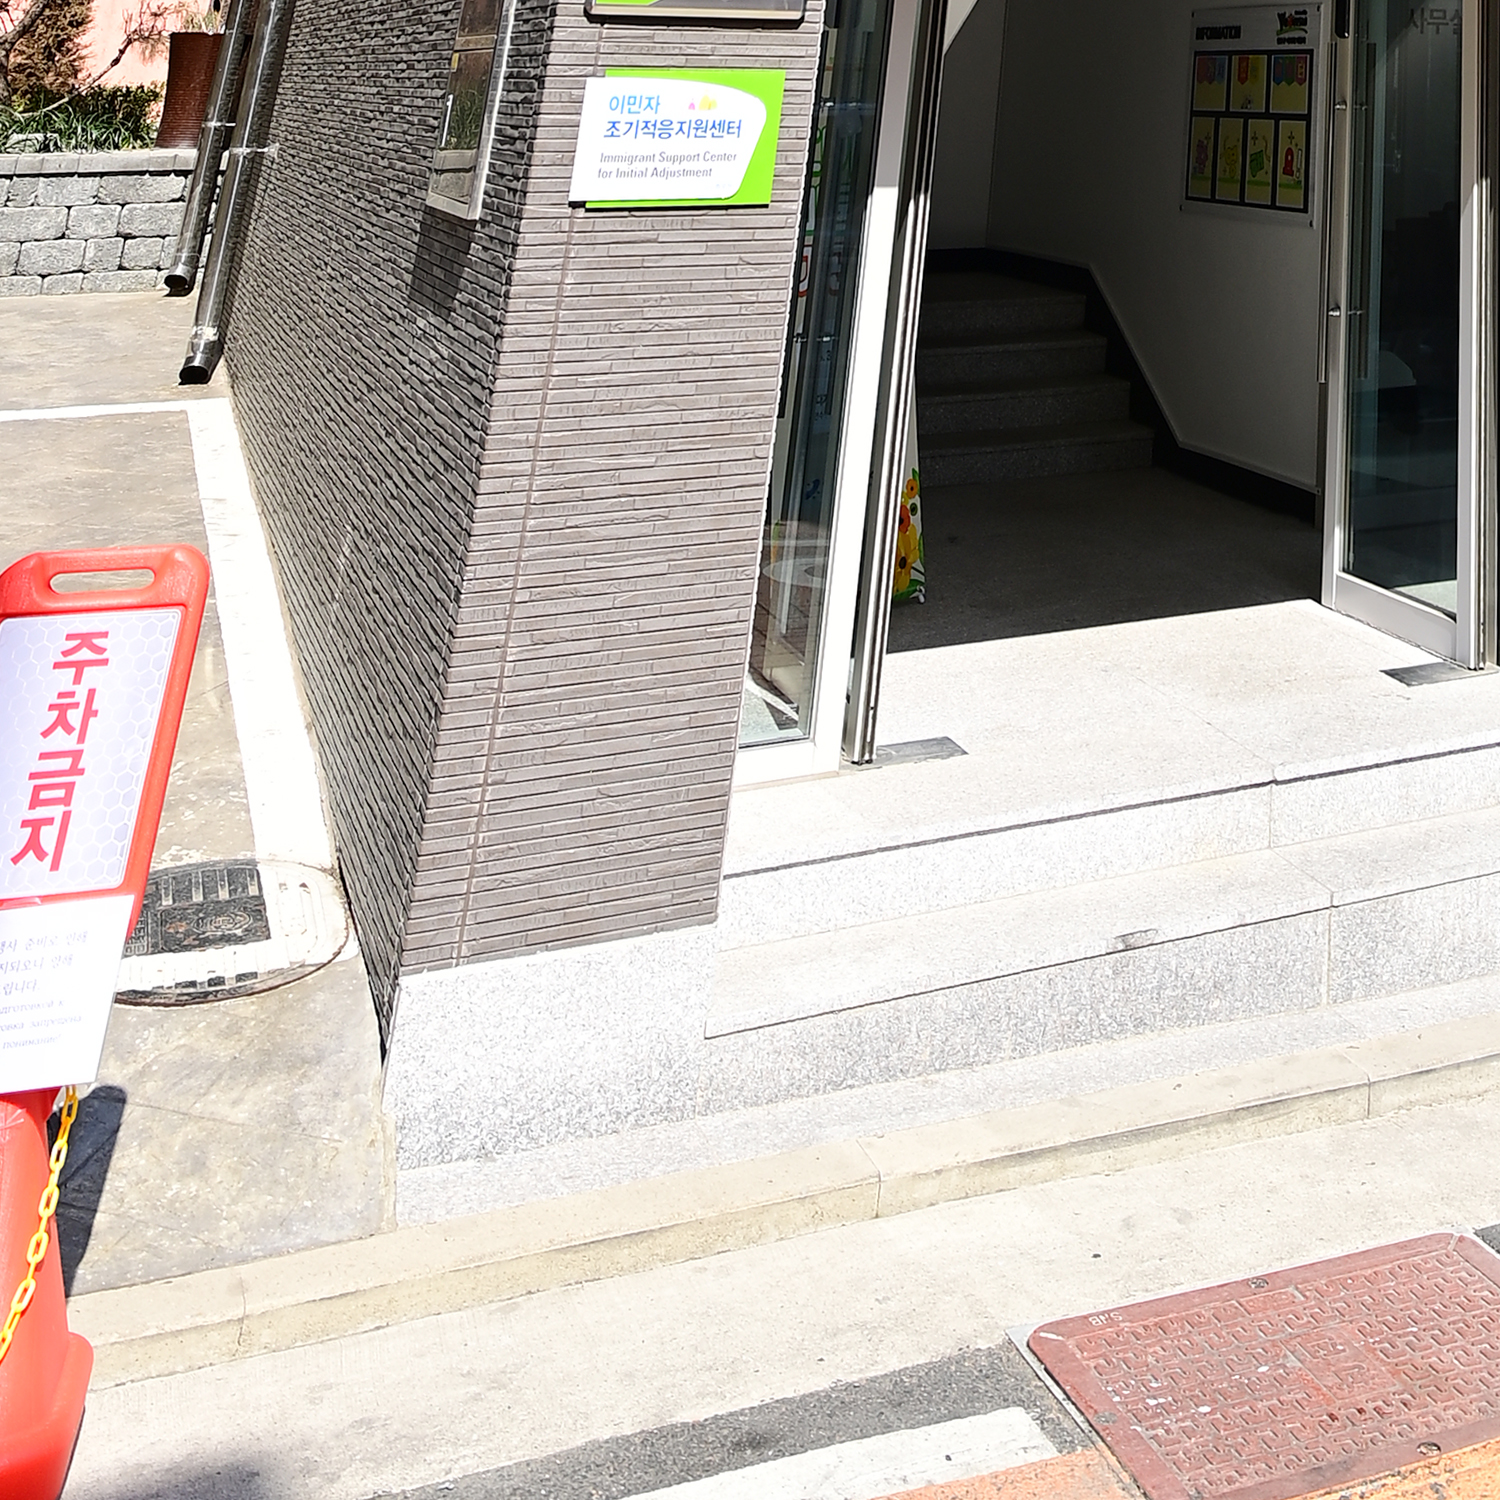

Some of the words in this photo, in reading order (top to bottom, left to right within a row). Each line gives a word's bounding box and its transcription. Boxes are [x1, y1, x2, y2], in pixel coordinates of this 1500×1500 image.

[609, 95, 661, 114] 이민자
[603, 119, 742, 139] 조기적응지원센터
[600, 152, 656, 165] Immigrant
[658, 151, 701, 165] Support
[703, 151, 737, 162] Center
[598, 168, 613, 179] for
[616, 168, 648, 179] Initial
[650, 167, 713, 180] Adjustment
[10, 631, 110, 872] 주차금지
